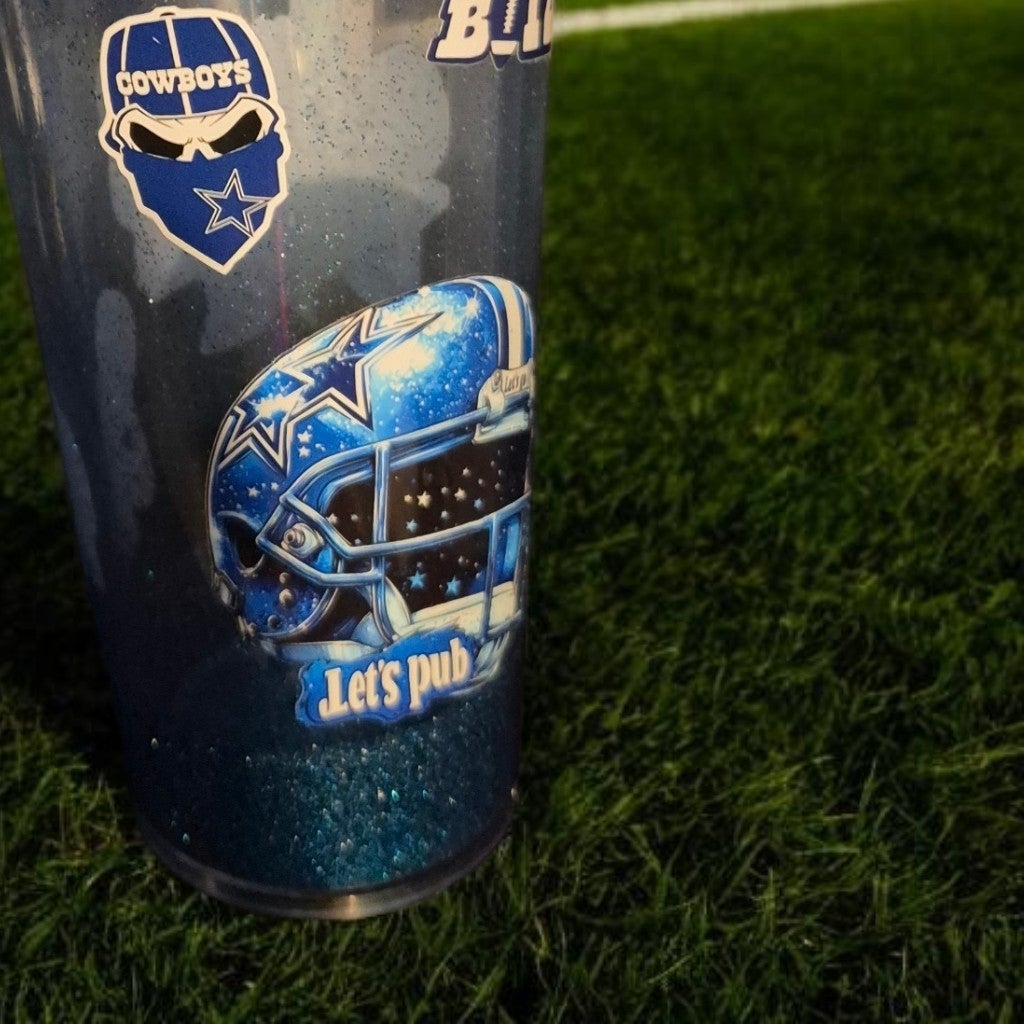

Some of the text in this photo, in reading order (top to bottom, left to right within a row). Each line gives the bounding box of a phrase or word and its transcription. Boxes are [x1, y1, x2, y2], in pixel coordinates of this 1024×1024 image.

[115, 58, 252, 97] COWBOYS
[318, 636, 471, 721] Let's pub
